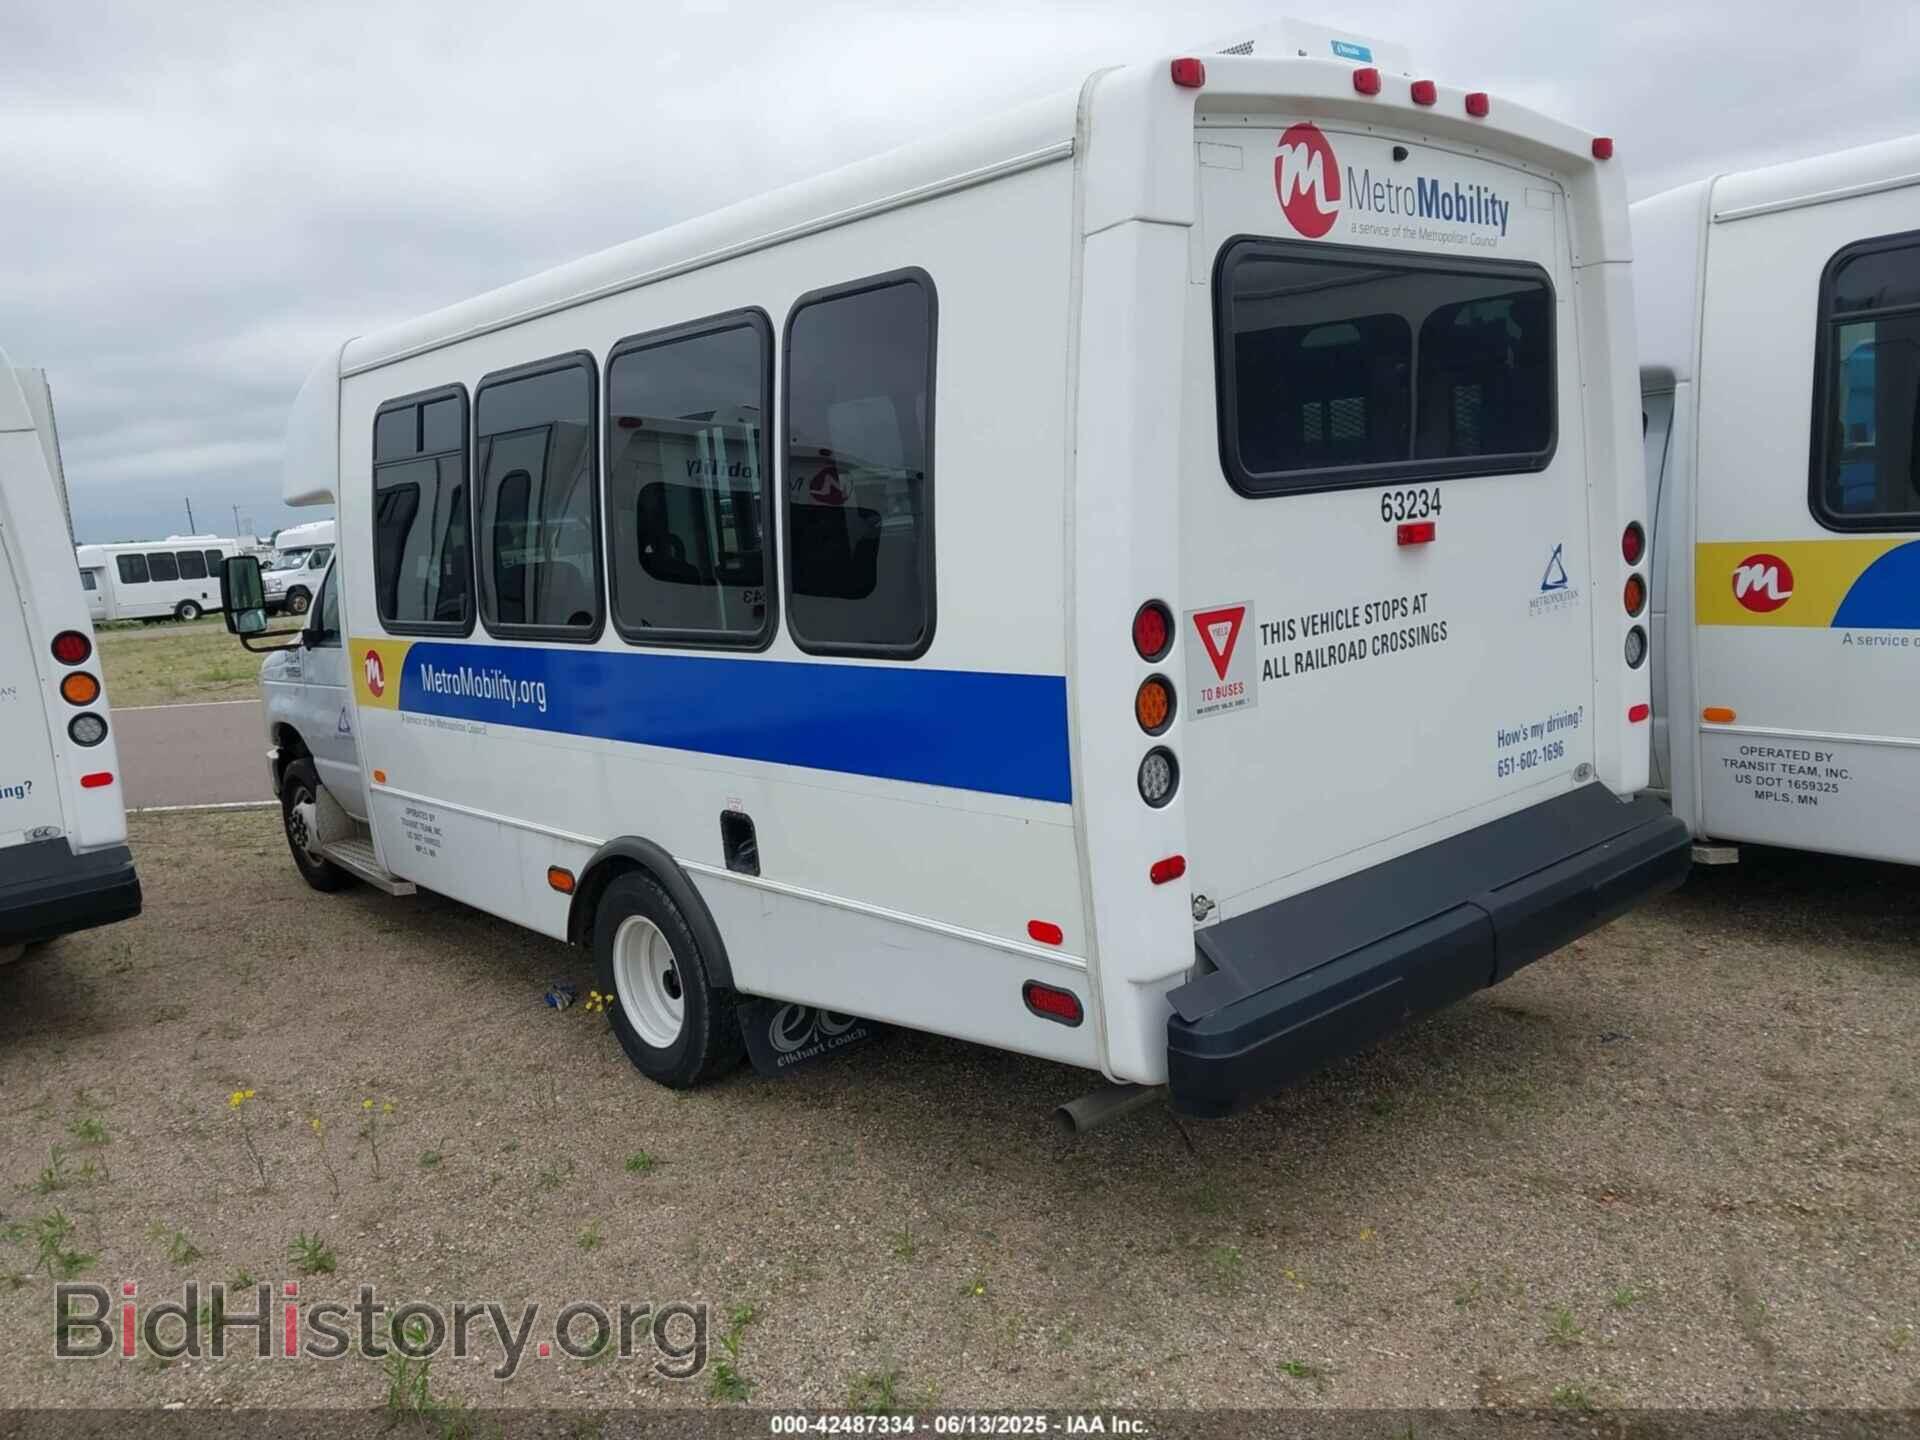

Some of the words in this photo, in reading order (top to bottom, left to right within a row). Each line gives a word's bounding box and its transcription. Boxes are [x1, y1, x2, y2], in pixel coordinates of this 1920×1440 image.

[1347, 166, 1509, 237] MetroMobility
[1351, 222, 1357, 233] a
[1359, 223, 1390, 236] service
[1392, 225, 1401, 238] of
[1403, 226, 1417, 240] the
[1419, 227, 1468, 245] Metropolitan
[1470, 232, 1498, 247] Council
[1381, 487, 1442, 523] 63234
[1260, 618, 1296, 646] THIS
[1300, 606, 1360, 638] VEHICLE
[1364, 596, 1408, 625] STOPS
[1412, 592, 1428, 615] AT
[1262, 655, 1290, 682] ALL
[1294, 638, 1367, 675] RAILROAD
[1372, 620, 1447, 656] CROSSINGS
[1842, 631, 1854, 645] A
[1857, 633, 1909, 647] service
[420, 663, 547, 713] MetroMobility.org
[1201, 687, 1213, 702] TO
[1215, 681, 1245, 699] BUSES
[1497, 722, 1529, 749] How's
[1530, 722, 1545, 740] my
[1546, 704, 1583, 733] driving?
[1497, 740, 1564, 778] 651-602-1696
[1740, 745, 1811, 761] OPERATED
[1815, 751, 1834, 762] BY
[1721, 758, 1777, 772] TRANSIT
[1780, 763, 1822, 778] TEAM,
[1825, 767, 1853, 780] INC.
[1735, 773, 1753, 785] US
[1756, 775, 1783, 788] DOT
[1787, 779, 1839, 794] 1659325
[1754, 790, 1794, 805] MPLS,
[1797, 794, 1819, 806] MN
